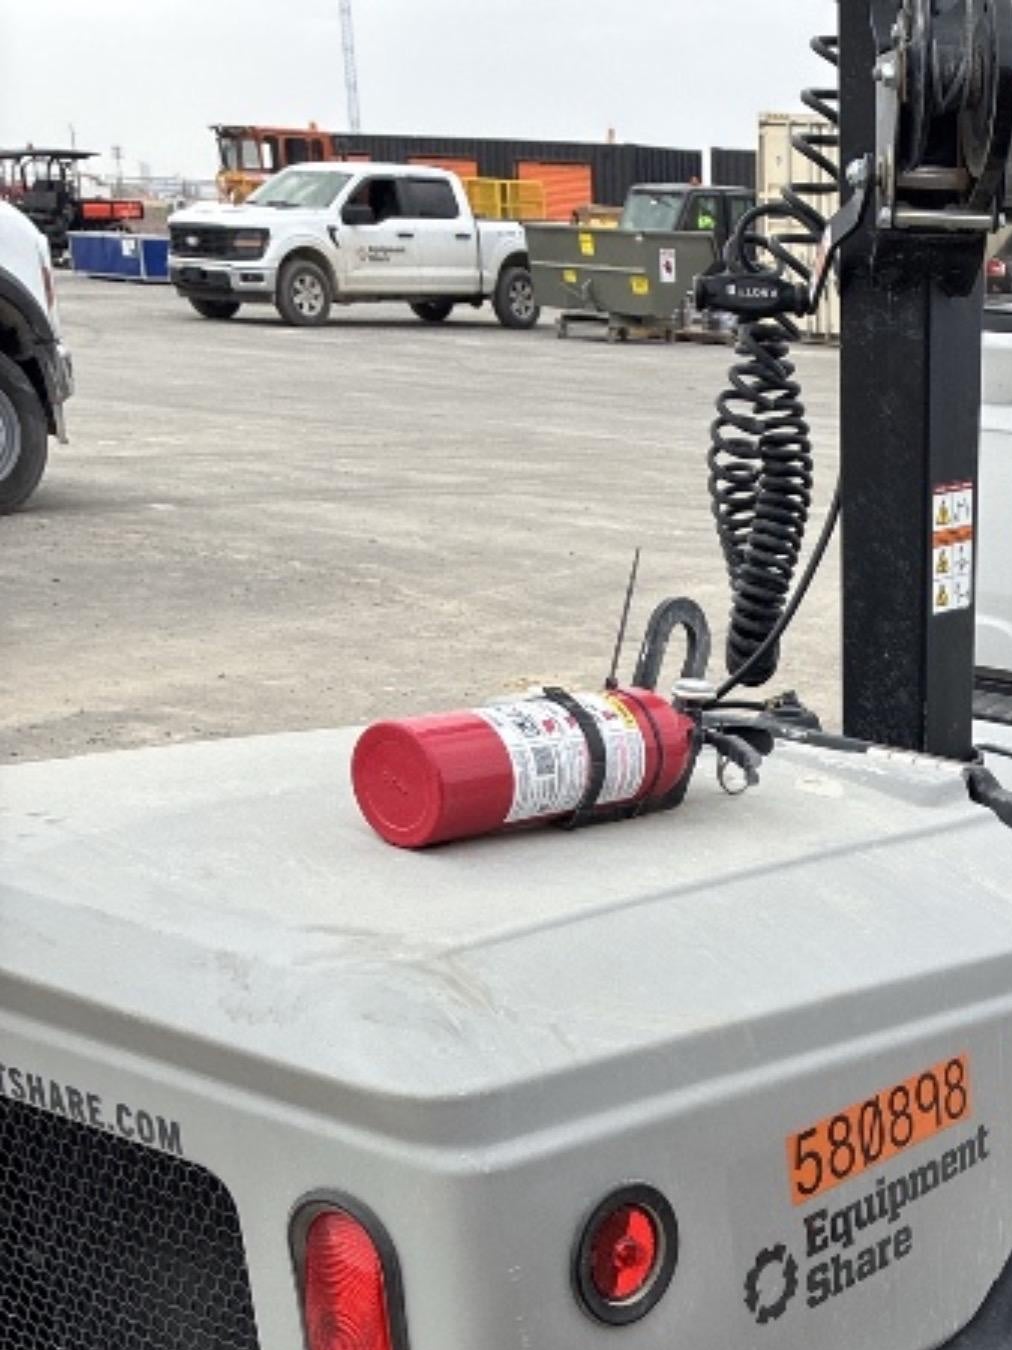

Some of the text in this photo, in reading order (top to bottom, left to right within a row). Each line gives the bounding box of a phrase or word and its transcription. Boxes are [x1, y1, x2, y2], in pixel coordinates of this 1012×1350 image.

[794, 1058, 967, 1195] 580898
[803, 1123, 990, 1258] Equipment
[805, 1224, 913, 1309] Share
